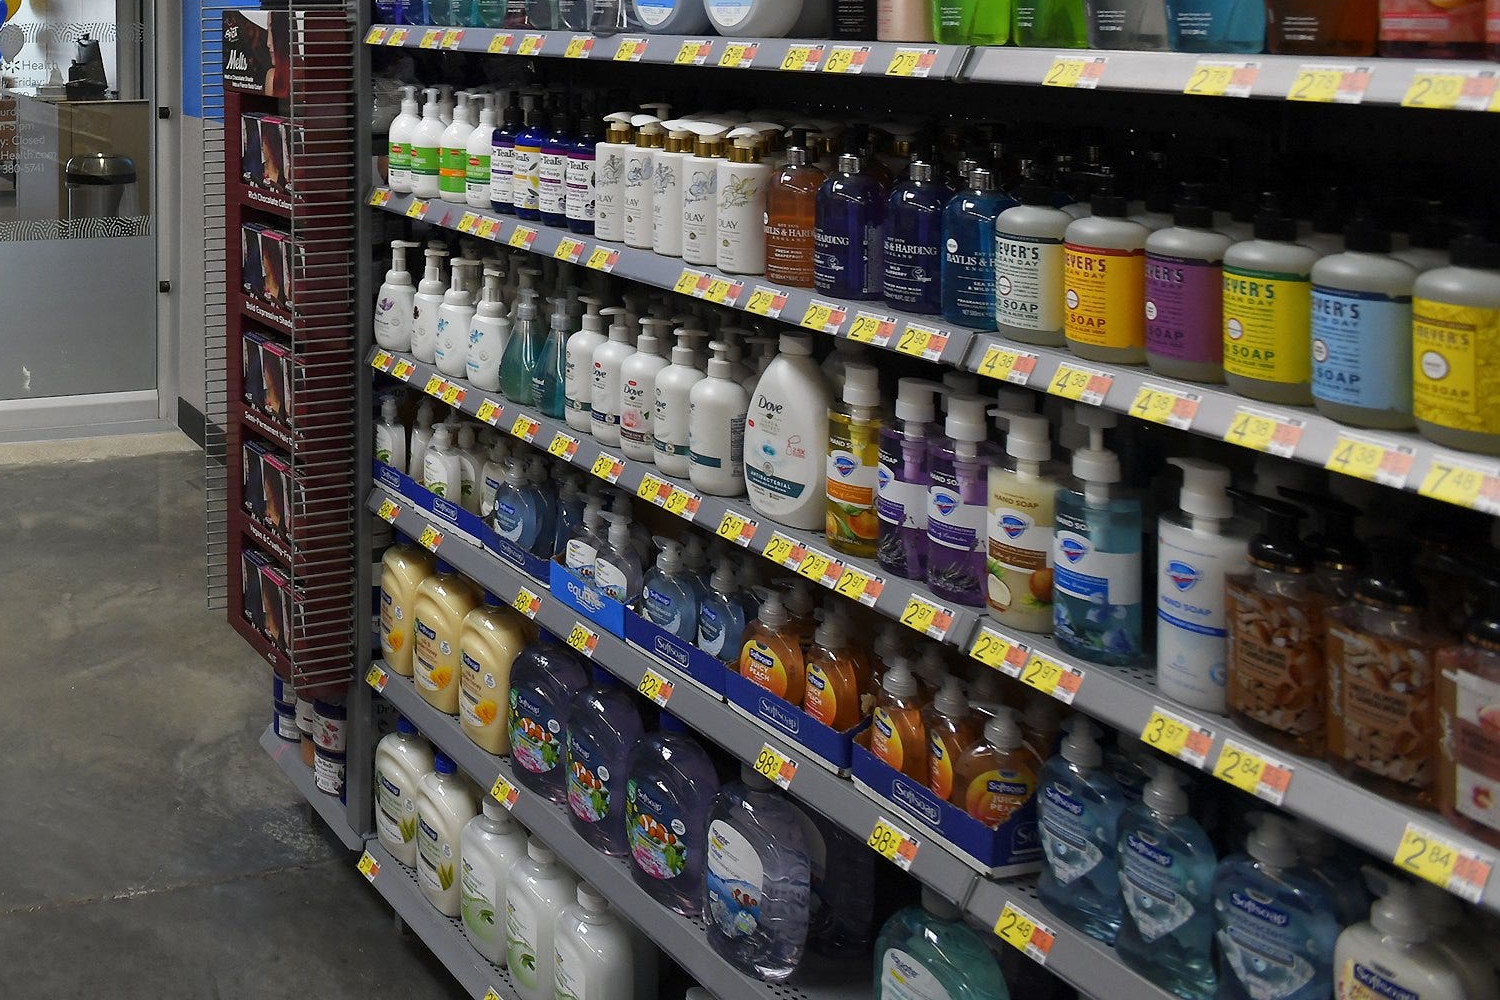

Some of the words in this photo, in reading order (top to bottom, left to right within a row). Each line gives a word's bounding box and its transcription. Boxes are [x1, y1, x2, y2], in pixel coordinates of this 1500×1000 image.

[22, 61, 58, 70] Health
[226, 50, 247, 71] Melts
[1190, 68, 1227, 94] 278
[1294, 72, 1334, 99] 278
[1408, 78, 1453, 107] 200
[12, 136, 45, 145] Closed
[258, 193, 278, 206] Chocolate
[684, 213, 705, 222] OLAY
[718, 219, 738, 229] OLAY
[896, 243, 937, 255] HARDING
[947, 253, 975, 266] BAYLIS
[1022, 260, 1039, 268] DAY
[804, 306, 827, 325] 299
[1008, 300, 1039, 313] SOAP
[851, 318, 874, 338] 299
[1070, 313, 1106, 328] SOAP
[899, 330, 926, 351] 299
[984, 351, 1014, 374] 438
[1232, 343, 1276, 361] SOAP
[1056, 371, 1088, 392] 438
[1318, 371, 1360, 385] SOAP
[624, 384, 644, 397] Dove
[758, 394, 783, 414] Dove
[1233, 414, 1270, 440] 438
[1335, 442, 1376, 469] 438
[749, 470, 791, 491] ANTIBACTERIAL
[930, 473, 945, 484] HAND
[1432, 466, 1475, 494] 748
[994, 494, 1013, 504] HAND
[1015, 497, 1038, 509] SOAP
[719, 516, 741, 534] 647
[766, 536, 789, 558] 297
[801, 554, 826, 574] 297
[839, 571, 865, 592] 297
[567, 582, 601, 610] equate
[904, 602, 932, 624] 297
[973, 637, 1005, 659] 297
[749, 668, 770, 682] PEACH
[750, 662, 769, 673] JUICY
[1146, 717, 1184, 744] 397
[1221, 745, 1260, 779] 284
[895, 782, 938, 817] Softsoap
[869, 824, 897, 854] 98¢
[1128, 835, 1172, 866] Softsoap
[1403, 836, 1451, 871] 284
[1230, 891, 1288, 925] Softsoap
